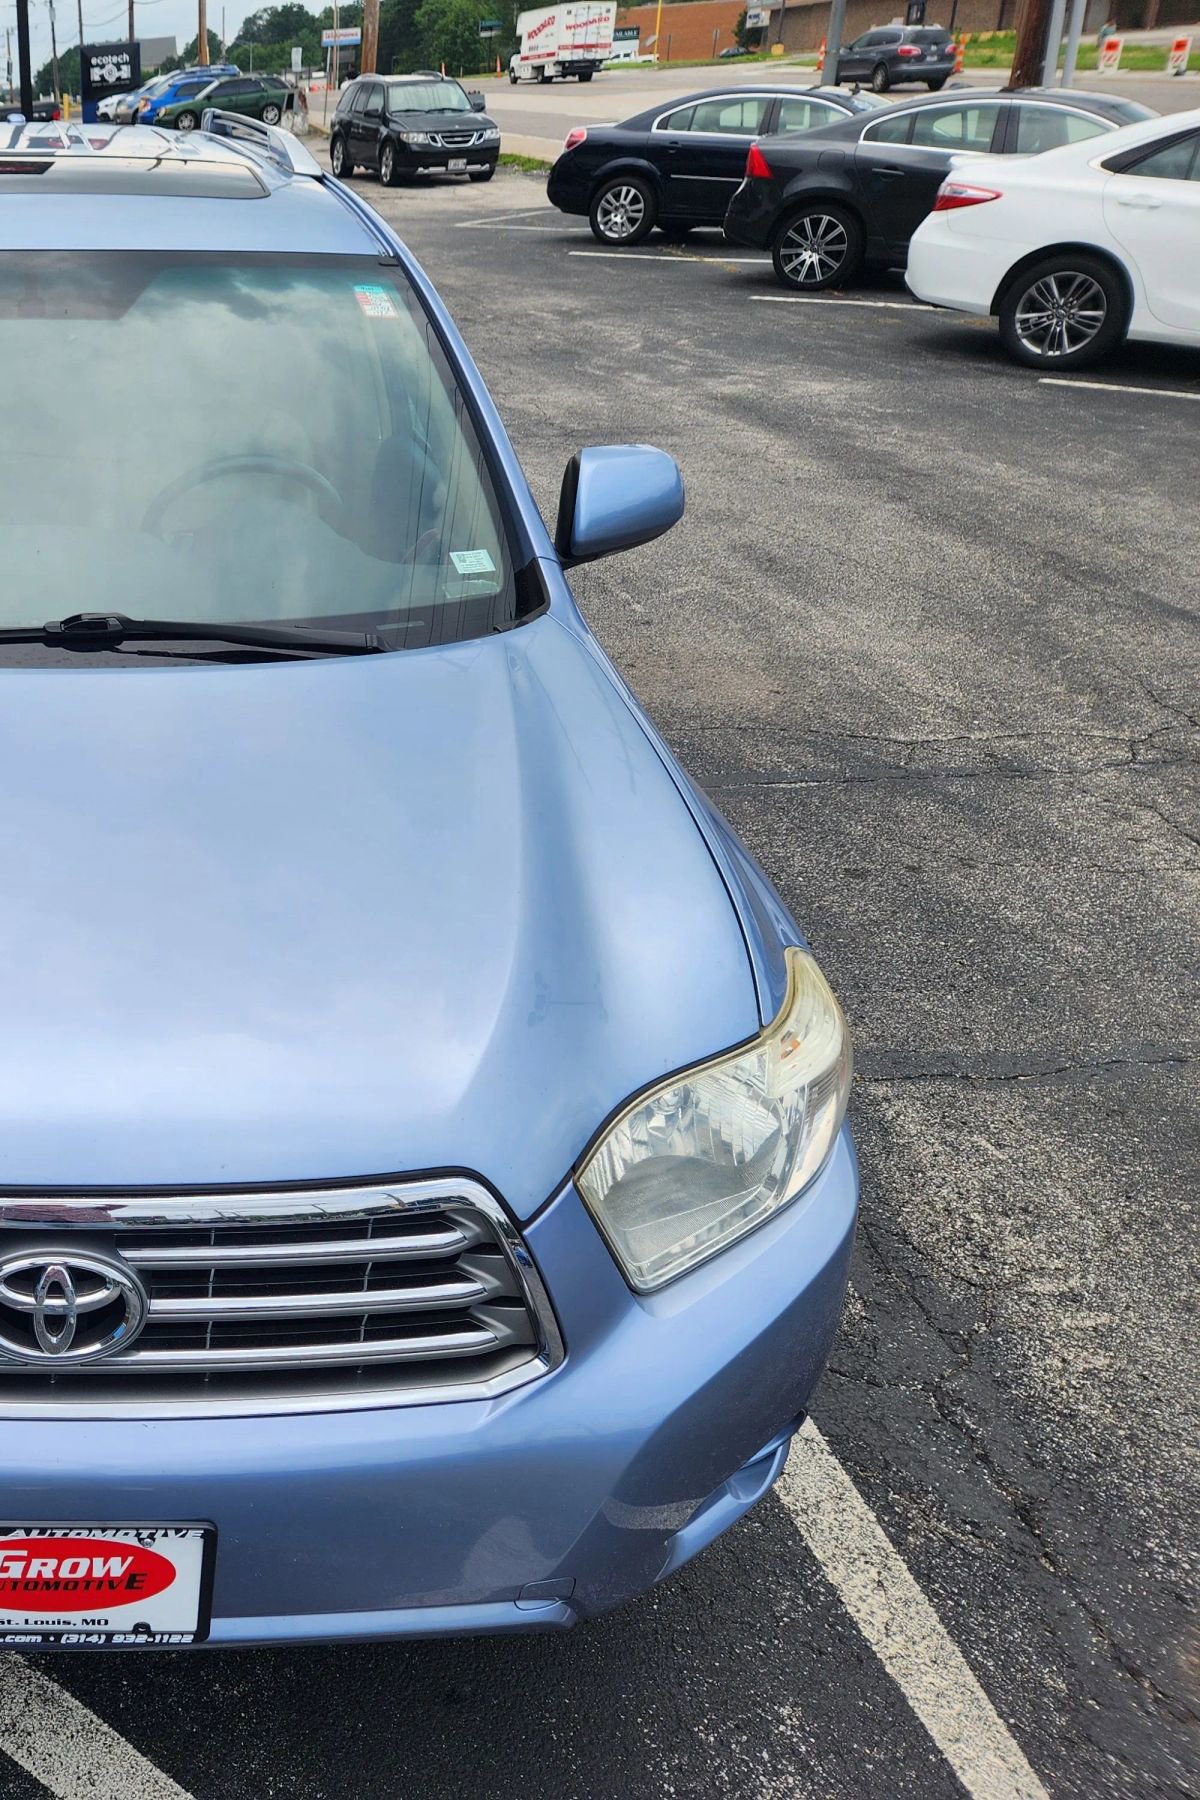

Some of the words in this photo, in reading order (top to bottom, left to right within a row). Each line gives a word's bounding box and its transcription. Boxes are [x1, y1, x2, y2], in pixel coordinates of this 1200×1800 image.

[90, 52, 130, 66] ecotech
[24, 1618, 77, 1626] Louis,
[81, 1618, 109, 1626] MO
[60, 1633, 106, 1644] (314)
[111, 1634, 194, 1643] 932-1122
